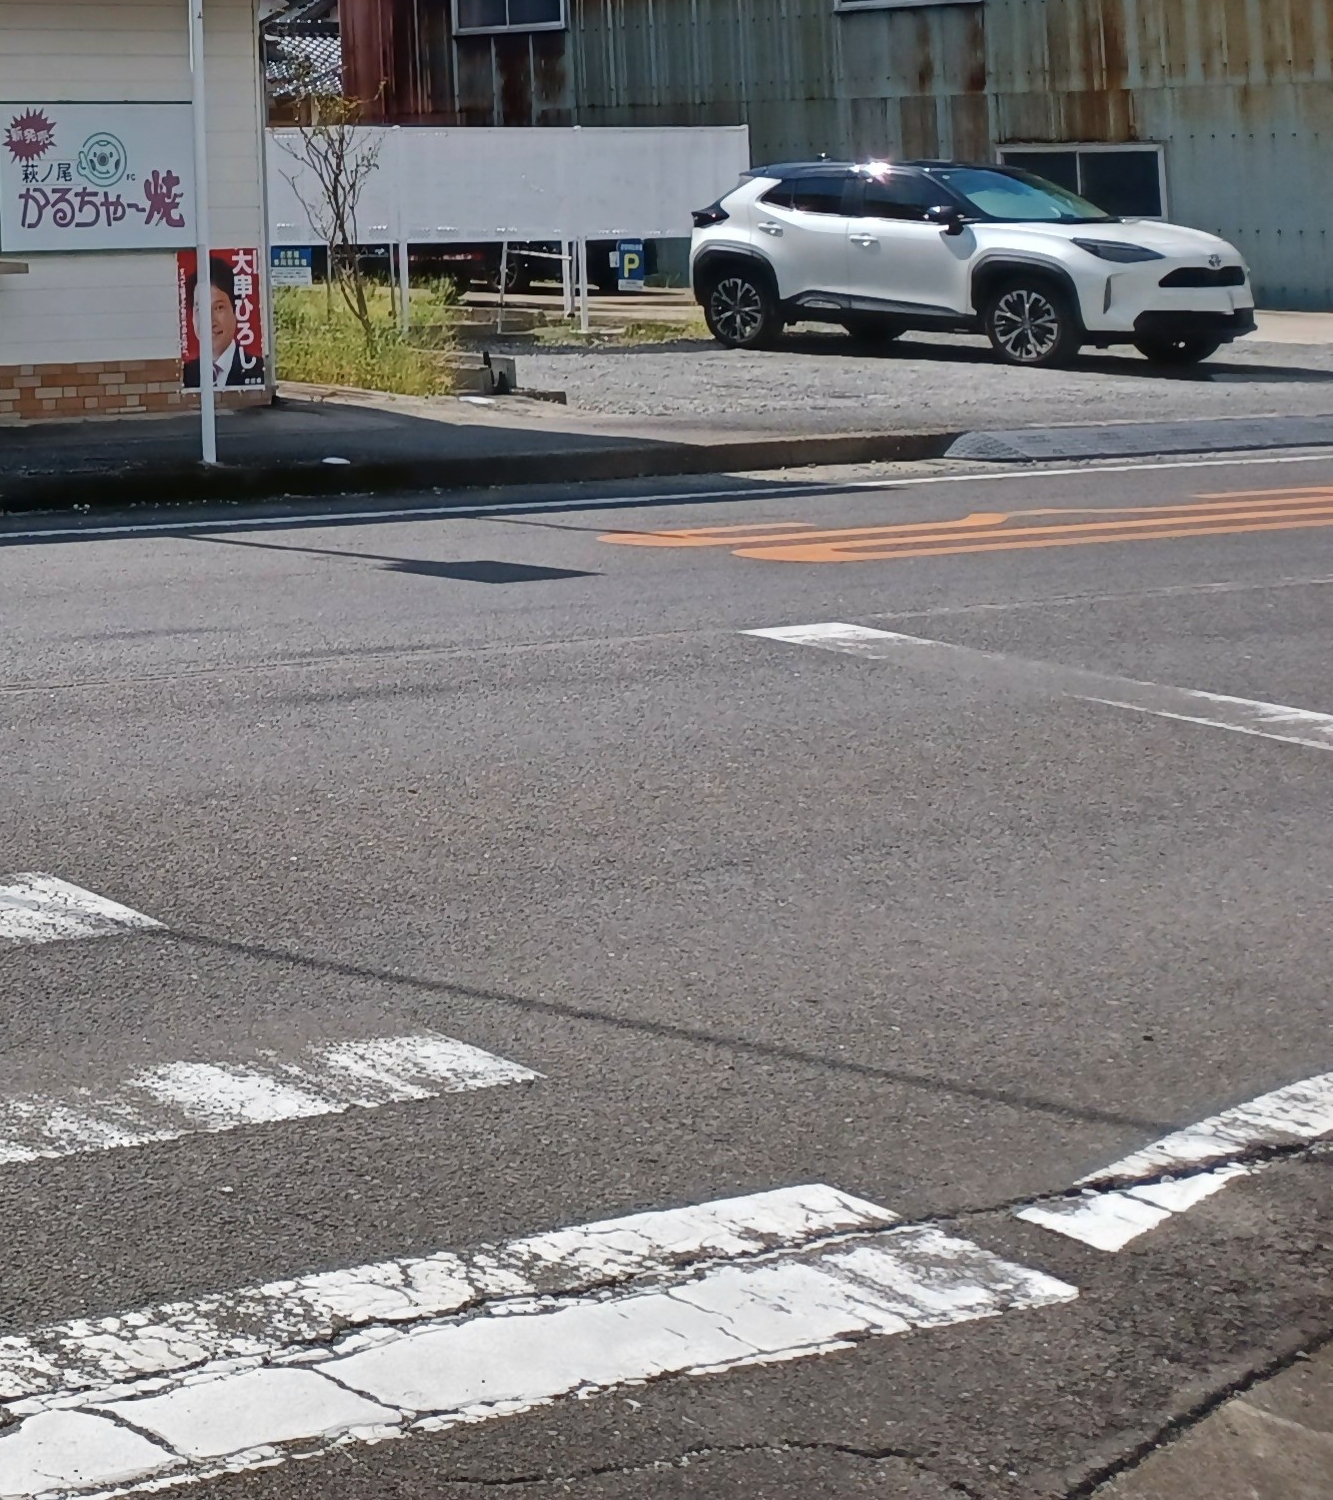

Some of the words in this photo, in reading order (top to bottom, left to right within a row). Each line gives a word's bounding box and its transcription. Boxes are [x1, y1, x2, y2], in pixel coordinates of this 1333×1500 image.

[10, 126, 51, 145] 新発売
[22, 162, 73, 183] 萩ノ尾
[624, 253, 640, 278] P
[232, 250, 257, 369] 大串ひろし
